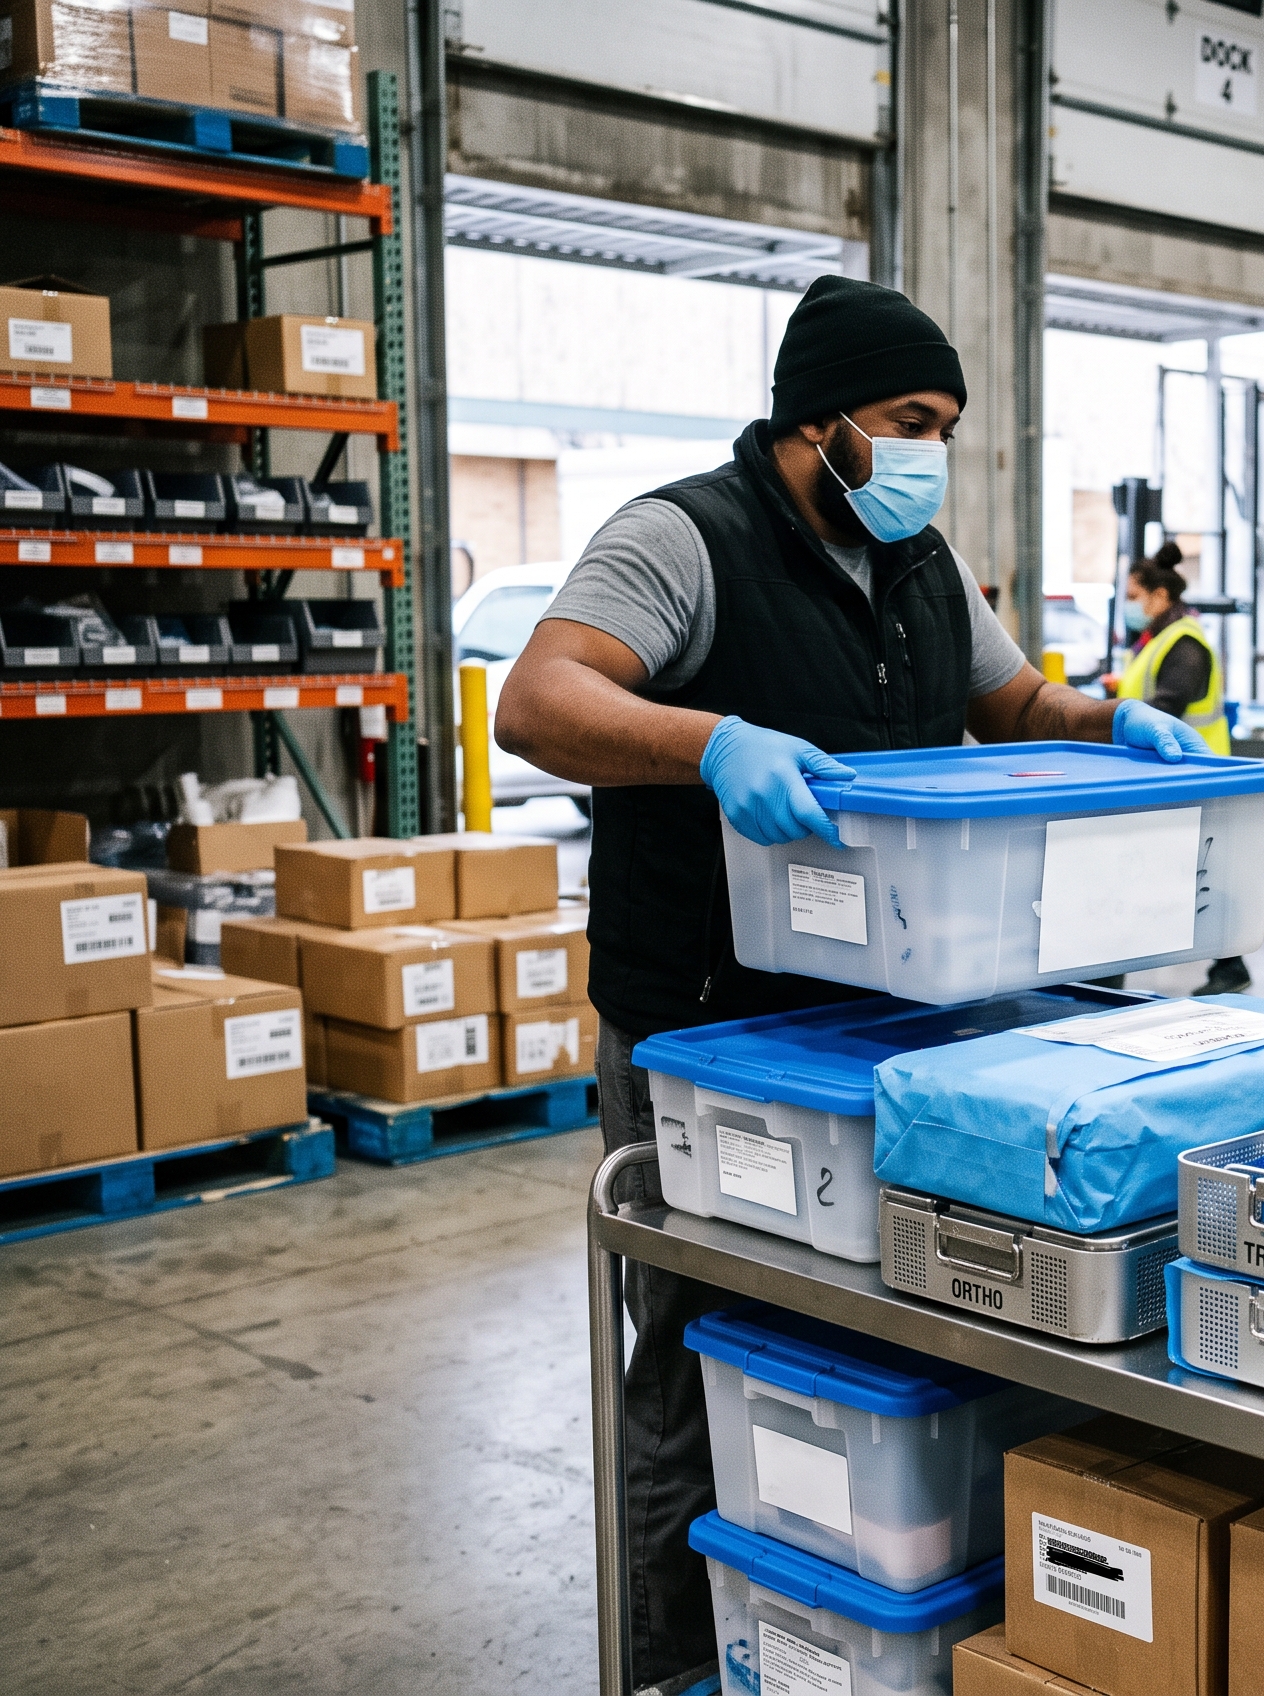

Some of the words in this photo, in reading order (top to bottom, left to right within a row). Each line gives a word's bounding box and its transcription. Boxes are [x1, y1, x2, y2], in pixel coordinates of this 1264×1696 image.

[1201, 35, 1252, 75] DOCK
[1221, 78, 1233, 104] 4
[816, 1167, 835, 1207] 2
[952, 1278, 1003, 1310] ORTHO
